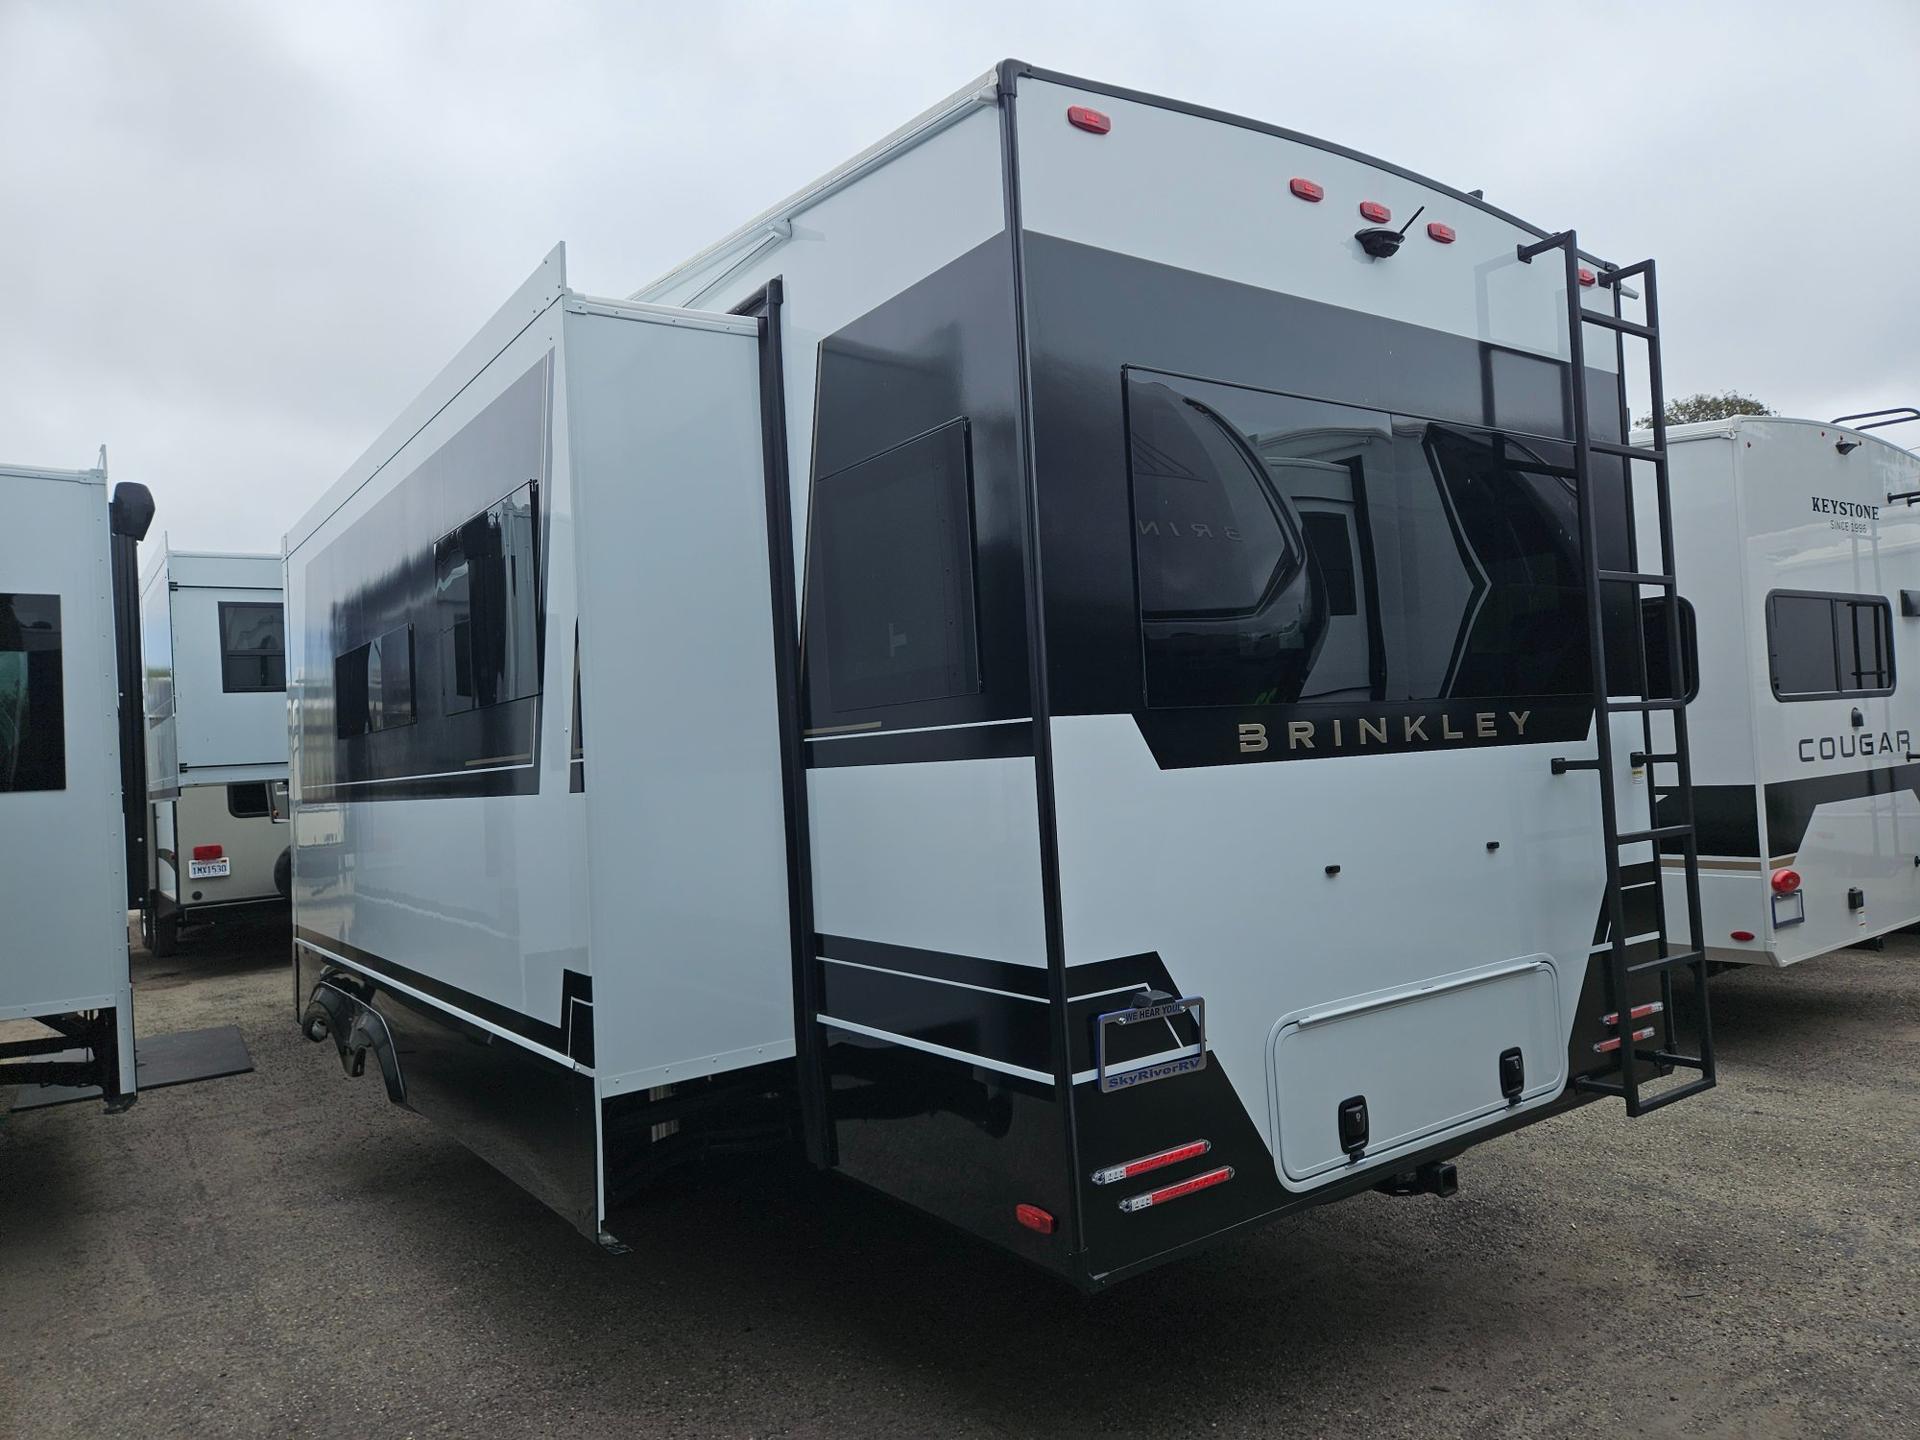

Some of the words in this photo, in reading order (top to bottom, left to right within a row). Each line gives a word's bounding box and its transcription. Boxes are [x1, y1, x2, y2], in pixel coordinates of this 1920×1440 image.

[1811, 497, 1879, 520] KEYSTONE
[1830, 520, 1849, 531] SINCE
[1238, 711, 1530, 753] BRINKLEY
[1799, 730, 1910, 762] COUGAR
[1124, 1011, 1137, 1022] WE
[1139, 1007, 1160, 1019] HEAR
[1108, 1059, 1200, 1088] SkyRiverRV
